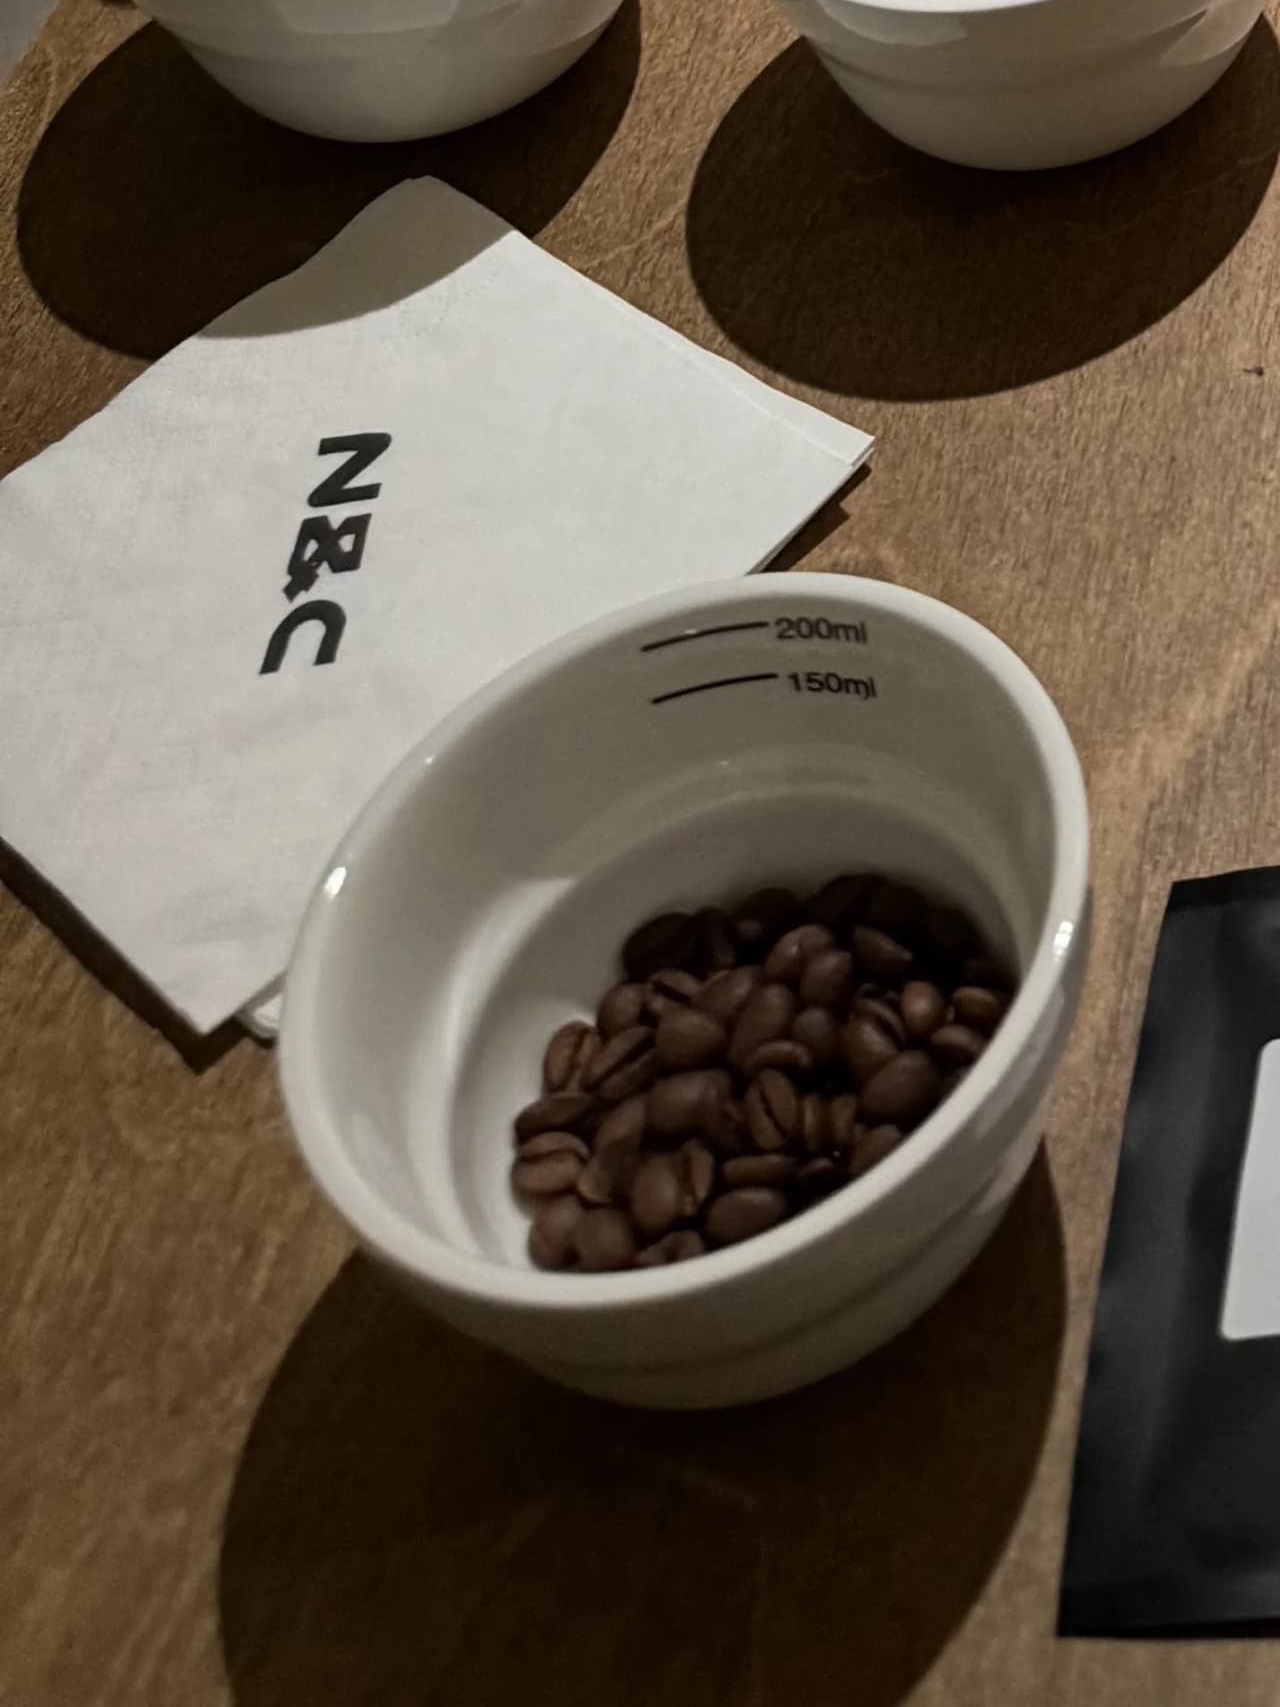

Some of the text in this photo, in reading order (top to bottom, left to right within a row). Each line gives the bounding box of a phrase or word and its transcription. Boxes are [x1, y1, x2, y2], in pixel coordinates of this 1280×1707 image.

[258, 432, 392, 675] N&C
[775, 617, 868, 643] 200ml
[787, 672, 878, 700] 150ml
